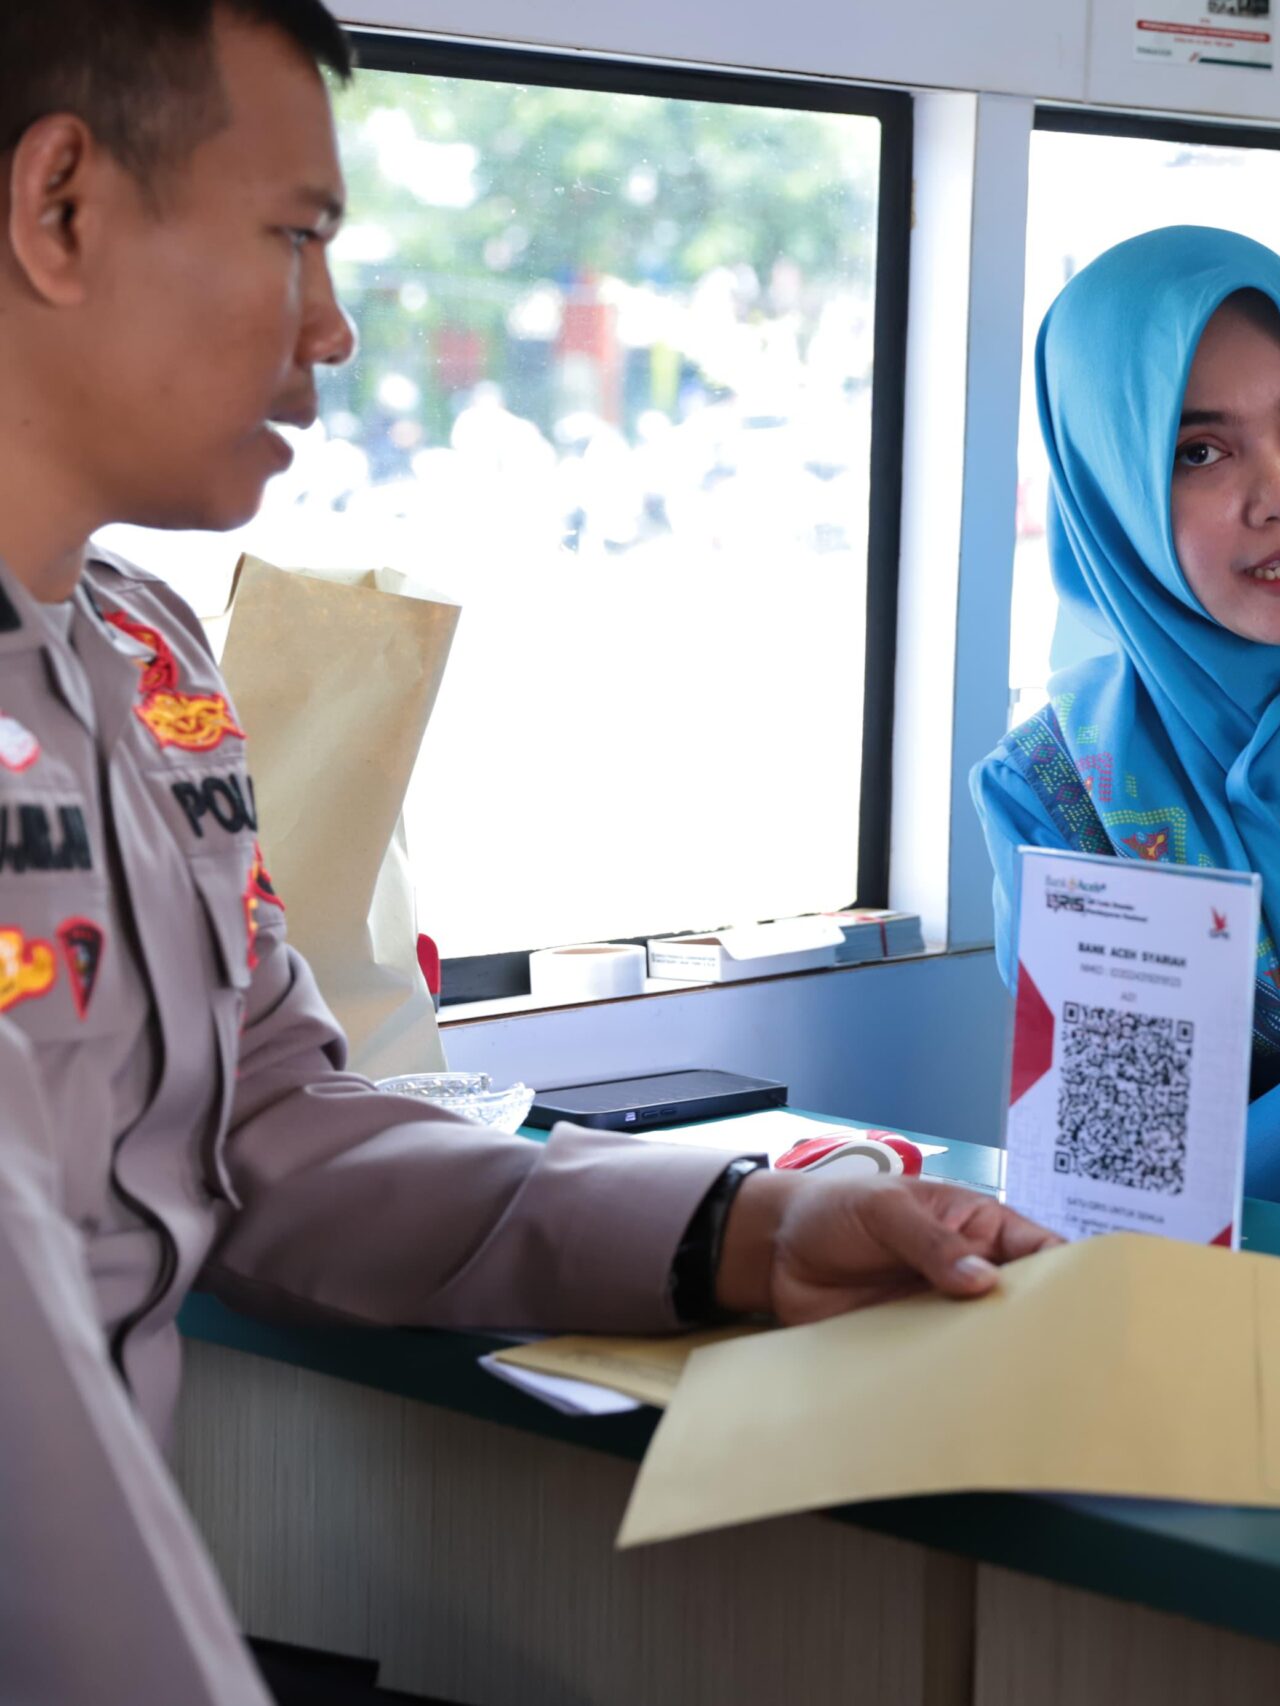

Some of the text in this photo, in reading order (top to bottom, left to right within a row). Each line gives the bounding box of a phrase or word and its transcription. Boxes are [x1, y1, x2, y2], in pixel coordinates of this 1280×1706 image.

[1078, 941, 1187, 968] BANK ACEH SYARIAH
